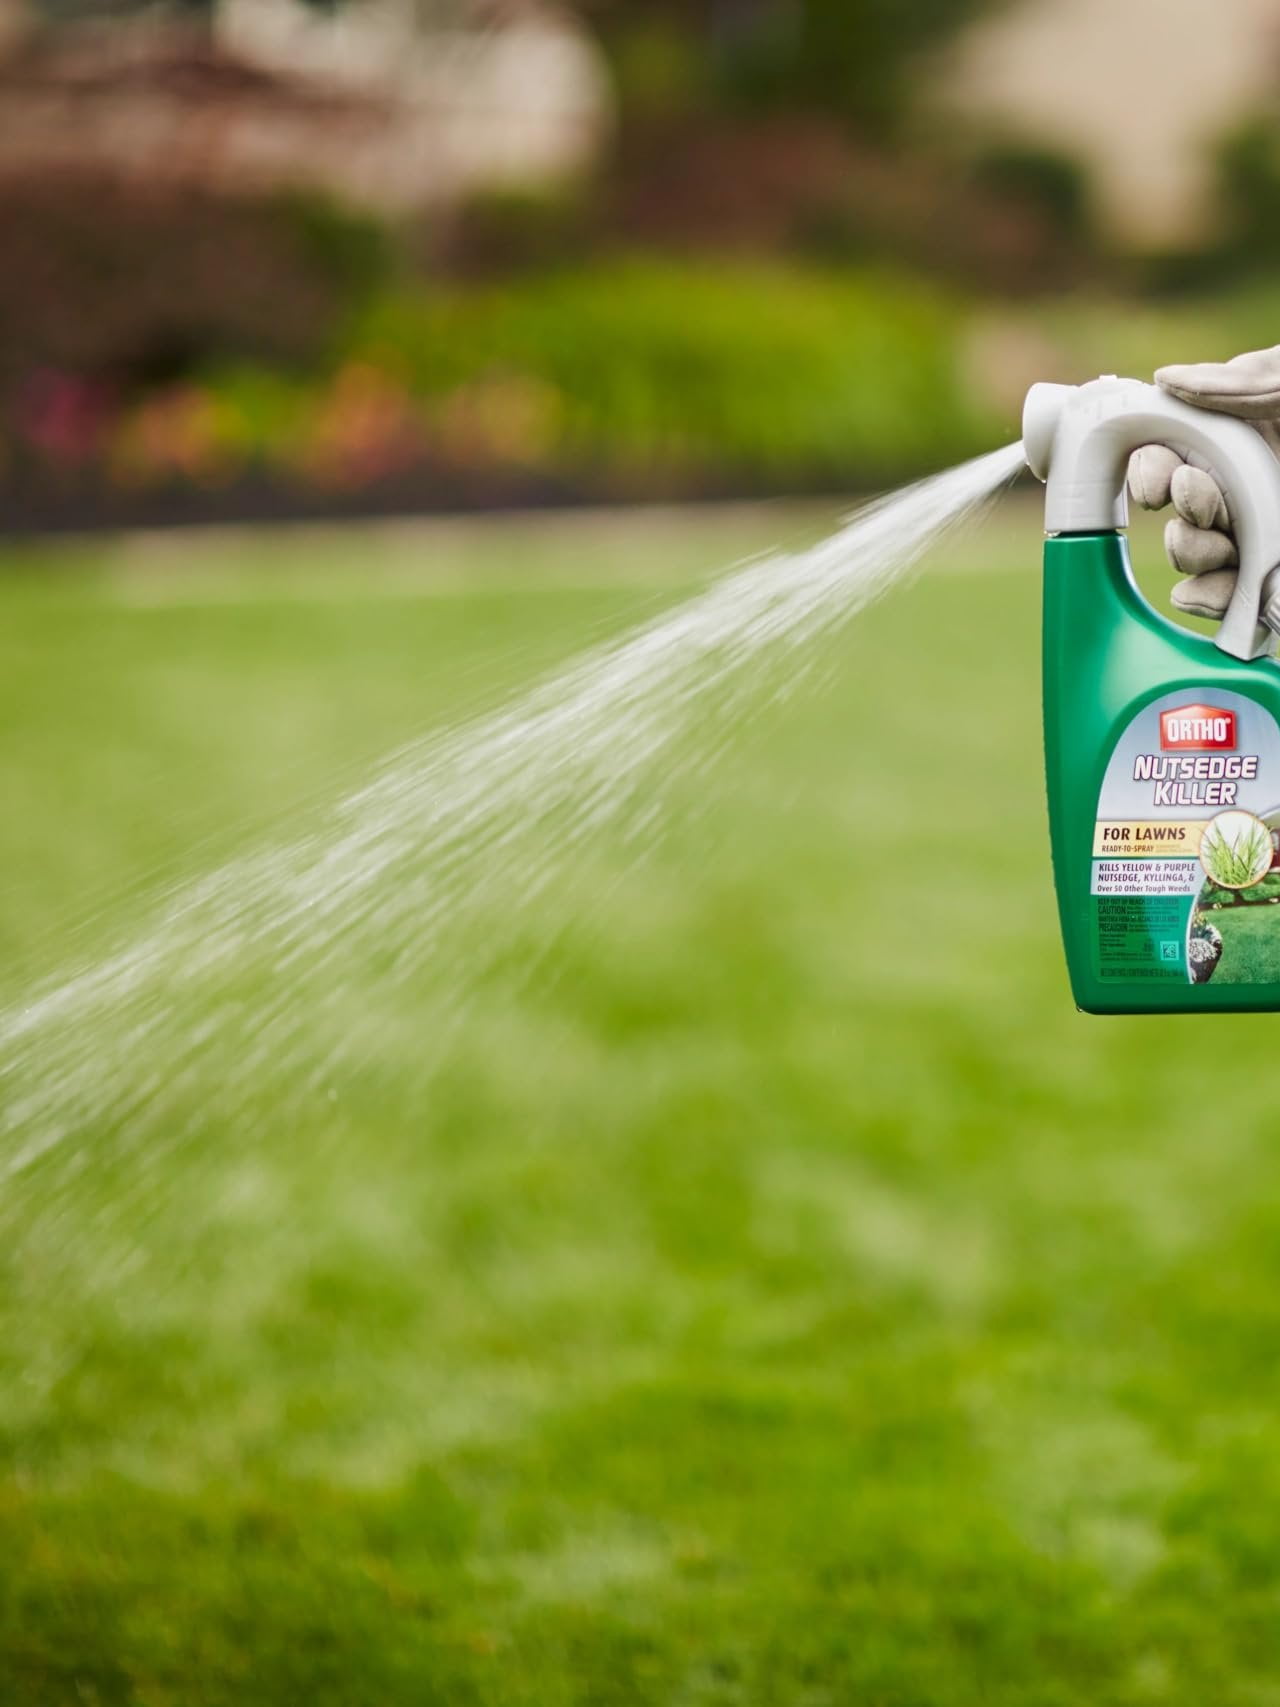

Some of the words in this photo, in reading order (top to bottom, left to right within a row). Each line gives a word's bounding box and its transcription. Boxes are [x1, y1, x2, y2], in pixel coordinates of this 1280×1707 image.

[1133, 754, 1258, 780] NUTSEDGE
[1154, 781, 1237, 805] KILLER
[1103, 828, 1130, 840] FOR
[1136, 828, 1186, 840] LAWNS
[1102, 844, 1154, 852] READY-TO-SPRAY
[1099, 864, 1119, 872] KILLS
[1122, 864, 1153, 872] YELLOW
[1164, 863, 1196, 871] PURPLE
[1098, 874, 1141, 883] NUTSEDGE,
[1143, 873, 1186, 883] KYLLINGA,
[1145, 885, 1166, 893] Tough
[1097, 905, 1126, 914] CAUTION
